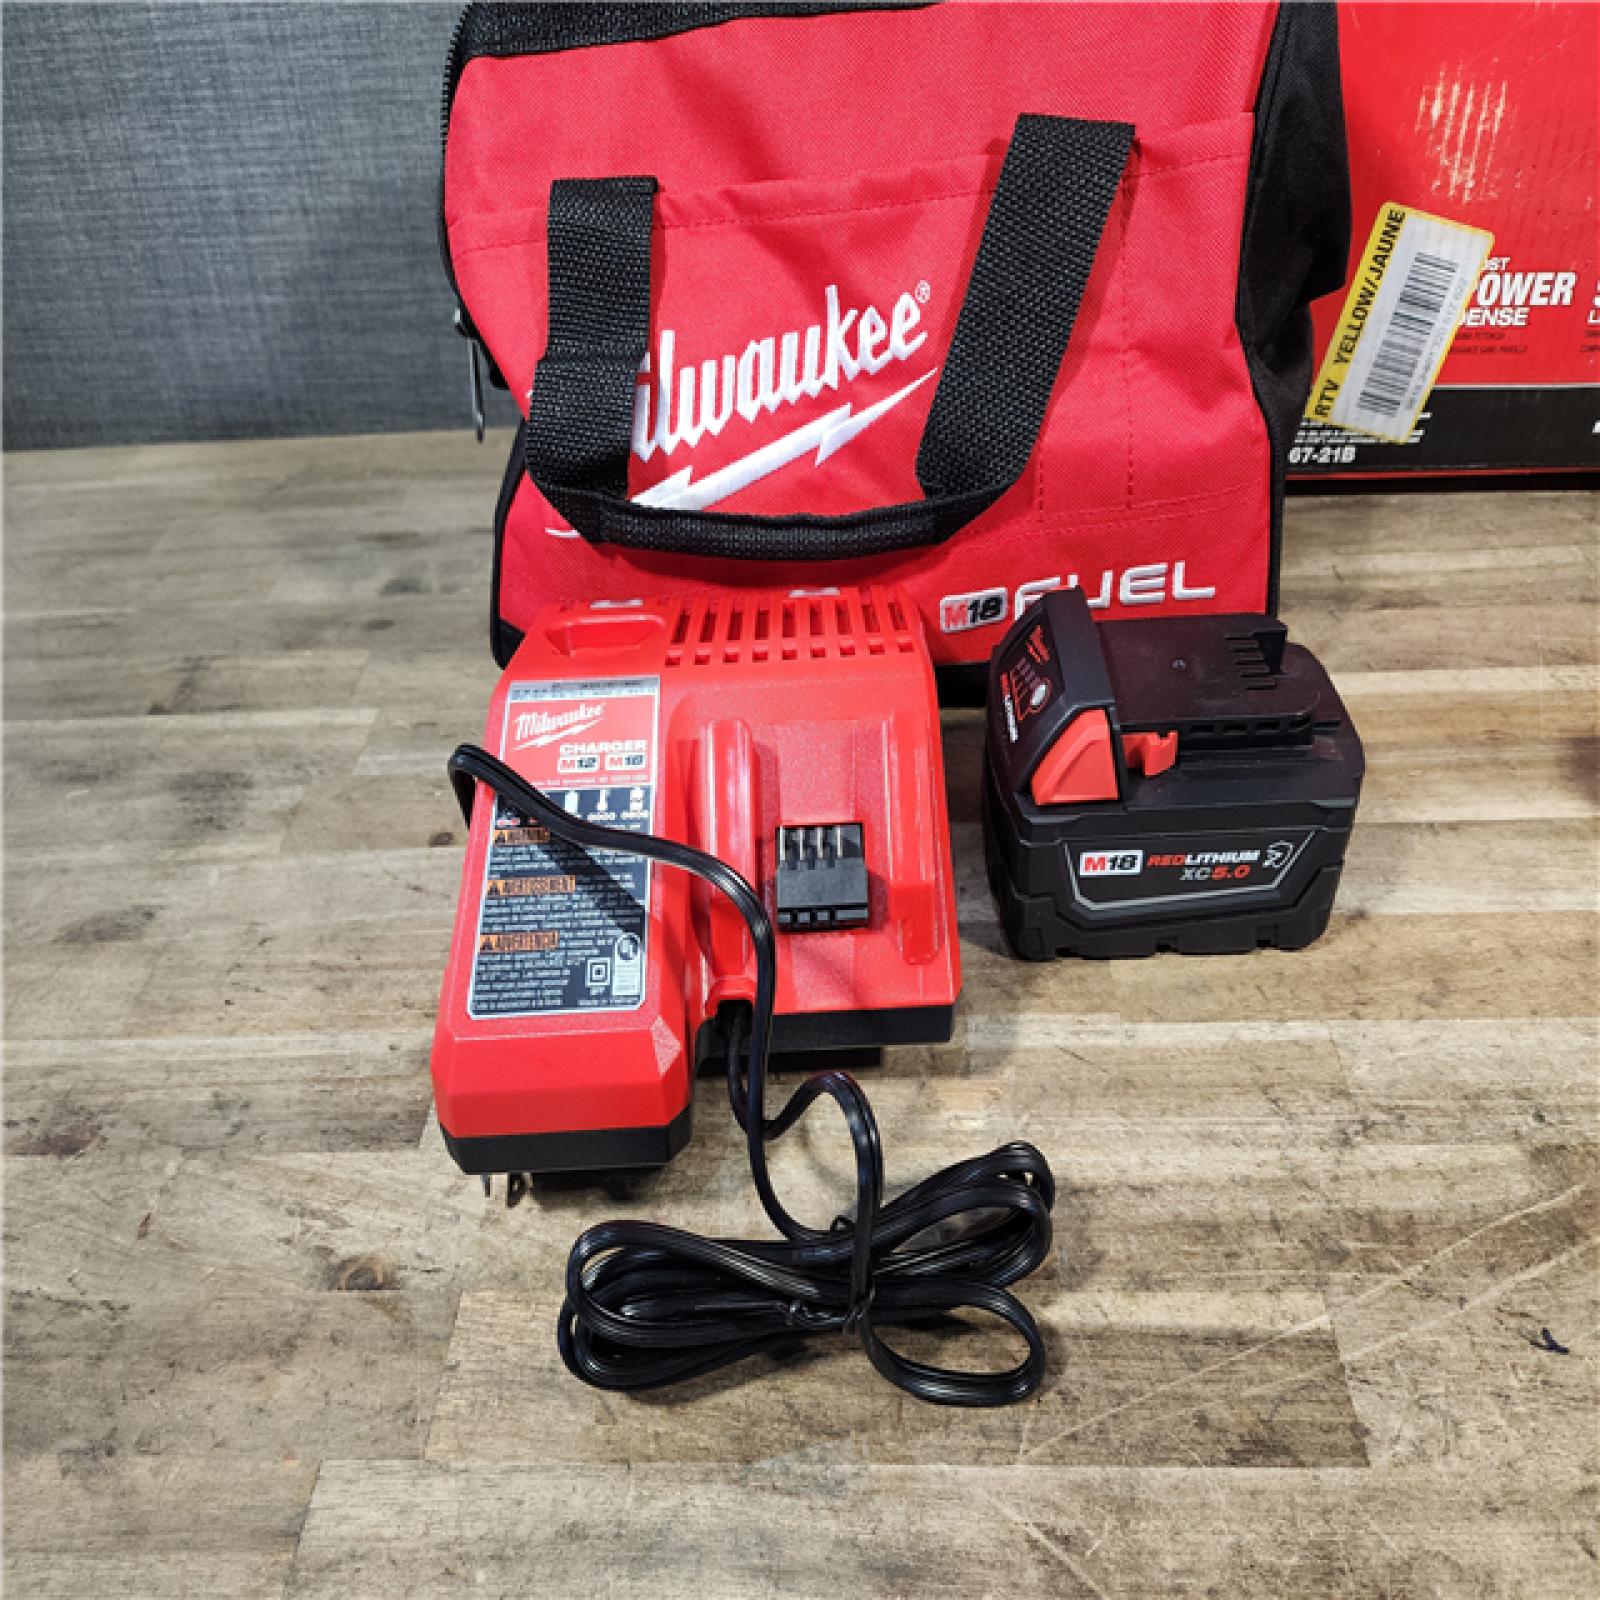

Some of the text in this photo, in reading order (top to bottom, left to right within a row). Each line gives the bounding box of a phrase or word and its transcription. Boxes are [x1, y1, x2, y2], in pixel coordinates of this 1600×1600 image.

[1476, 271, 1577, 306] OWER
[1314, 208, 1407, 418] RTV YELLOW/JAUNE
[1461, 307, 1531, 327] ENSE
[630, 282, 929, 462] ilwaukee
[942, 594, 1005, 629] M18
[559, 740, 647, 757] CHARGER
[1082, 852, 1141, 874] M18
